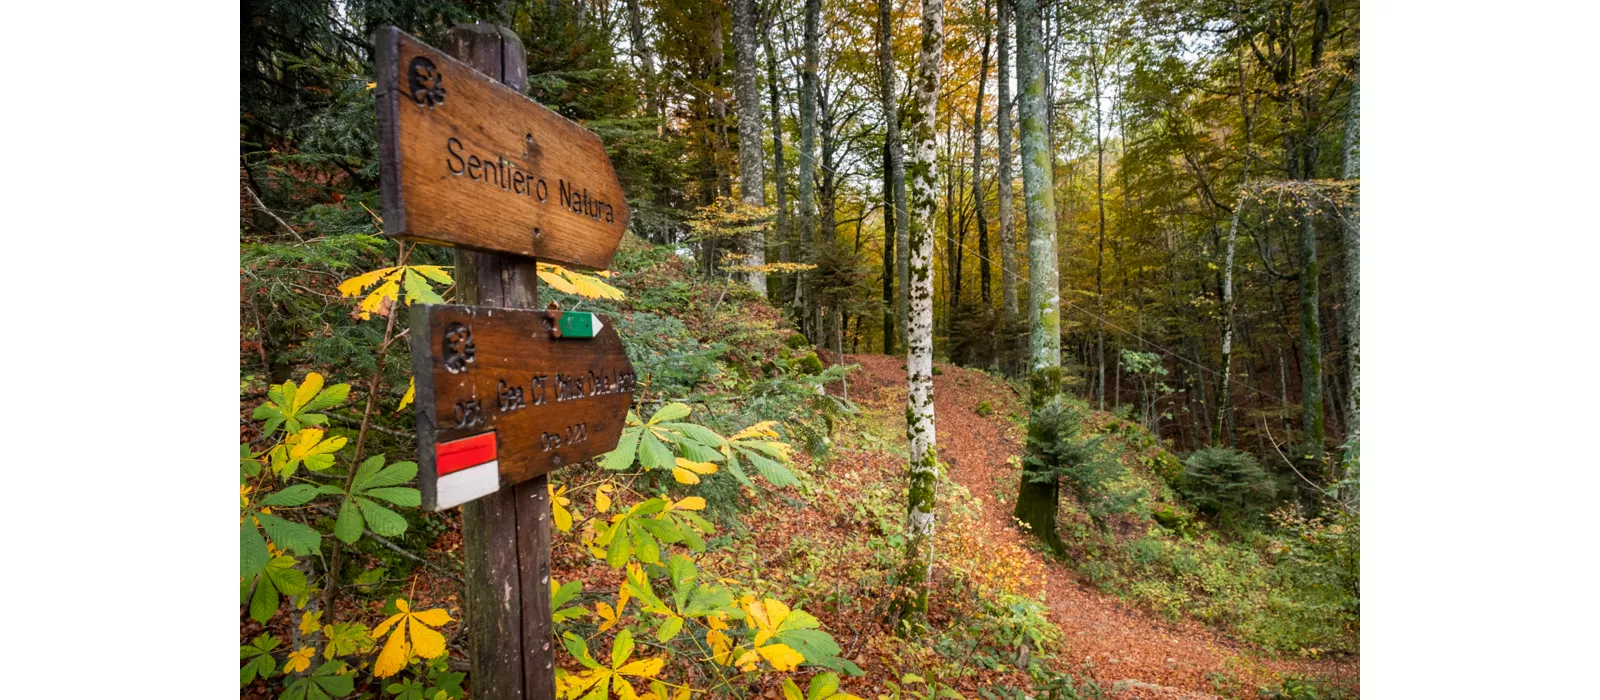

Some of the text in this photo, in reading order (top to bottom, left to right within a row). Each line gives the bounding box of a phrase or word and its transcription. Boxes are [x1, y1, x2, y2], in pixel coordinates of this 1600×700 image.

[446, 136, 615, 225] Sentiero Natura
[496, 378, 526, 412] Gea
[531, 375, 548, 406] CT
[540, 431, 561, 452] Ore
